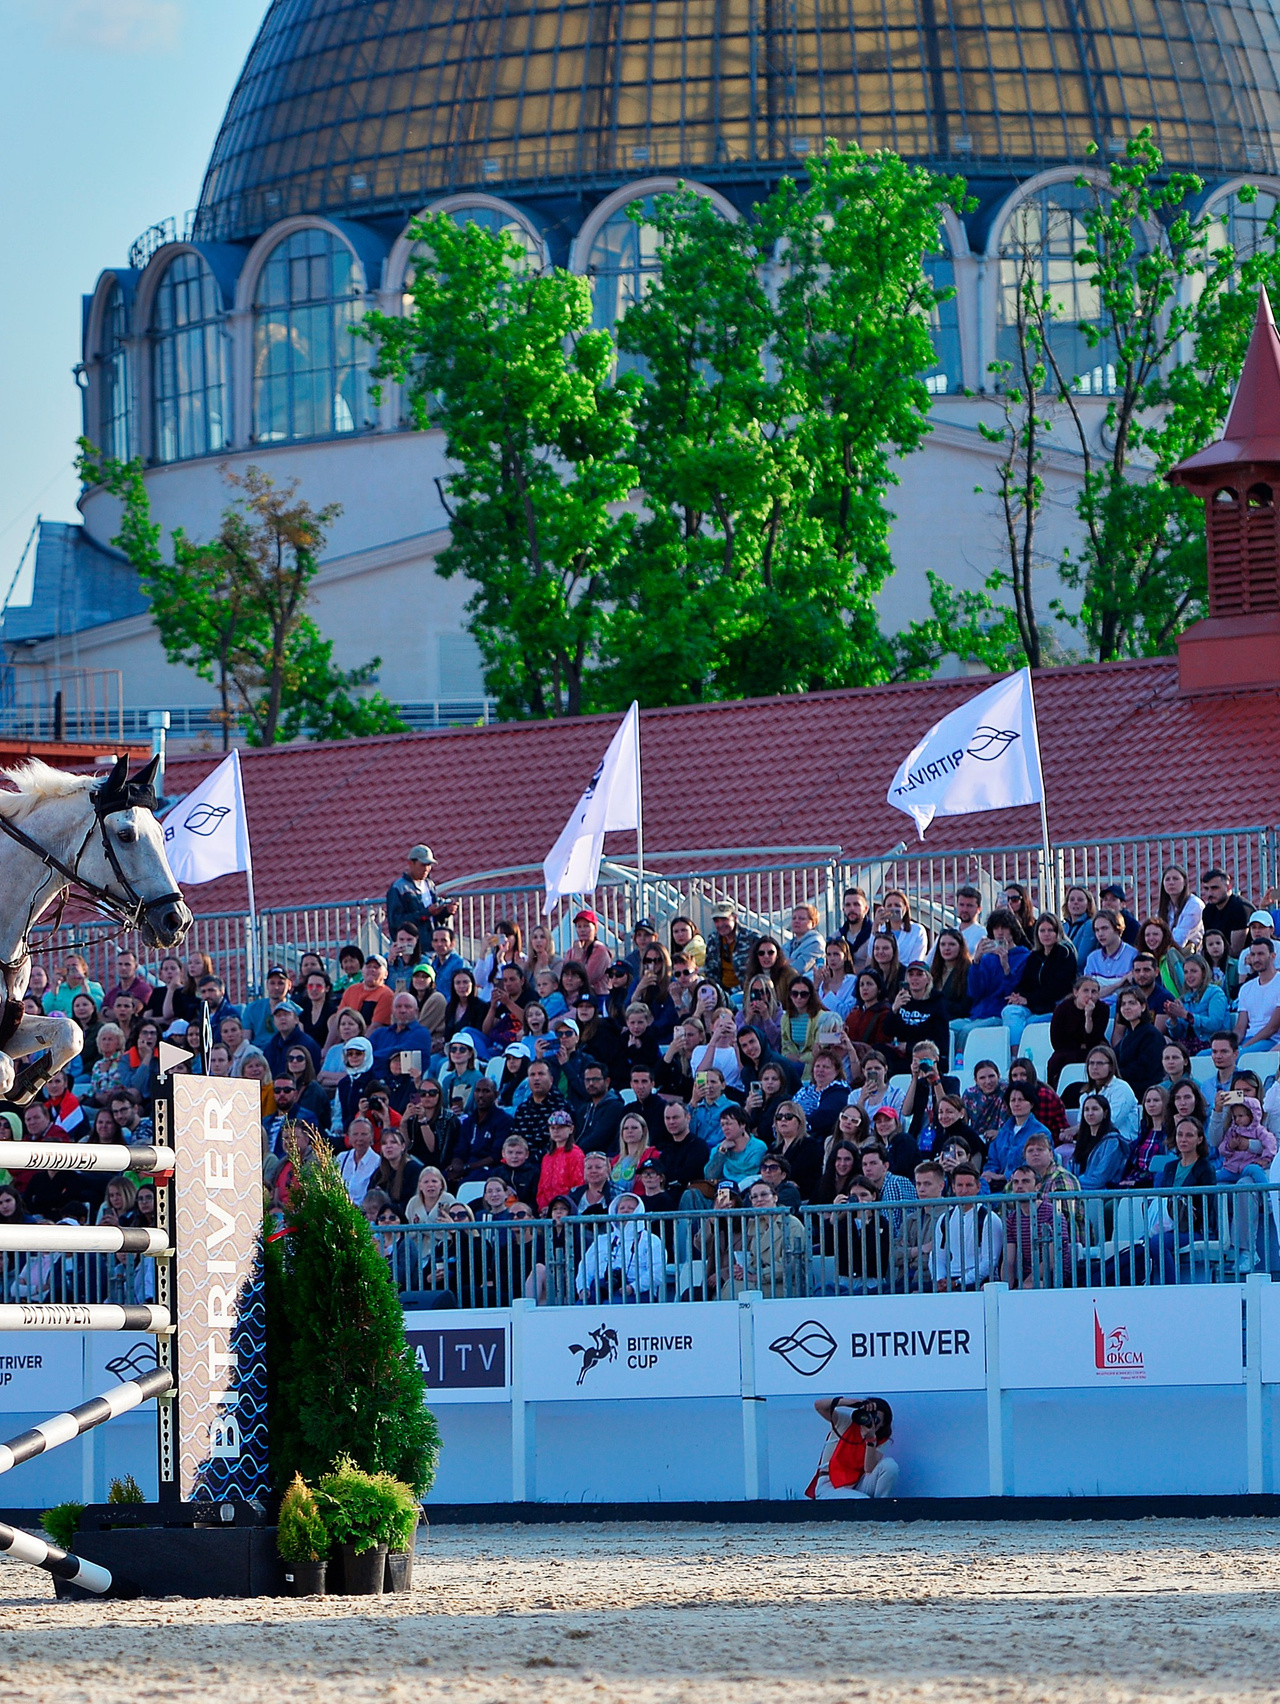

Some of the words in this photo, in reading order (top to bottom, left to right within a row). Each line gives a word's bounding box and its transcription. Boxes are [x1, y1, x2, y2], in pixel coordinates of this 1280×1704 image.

[24, 1151, 98, 1170] BITRIVER
[204, 1097, 241, 1458] BITRIVER
[20, 1305, 91, 1324] BITRIVER
[627, 1335, 693, 1351] BITRIVER
[851, 1329, 970, 1358] BITRIVER
[455, 1343, 497, 1371] TV
[627, 1355, 658, 1369] CUP
[1106, 1351, 1144, 1364] ФКСМ
